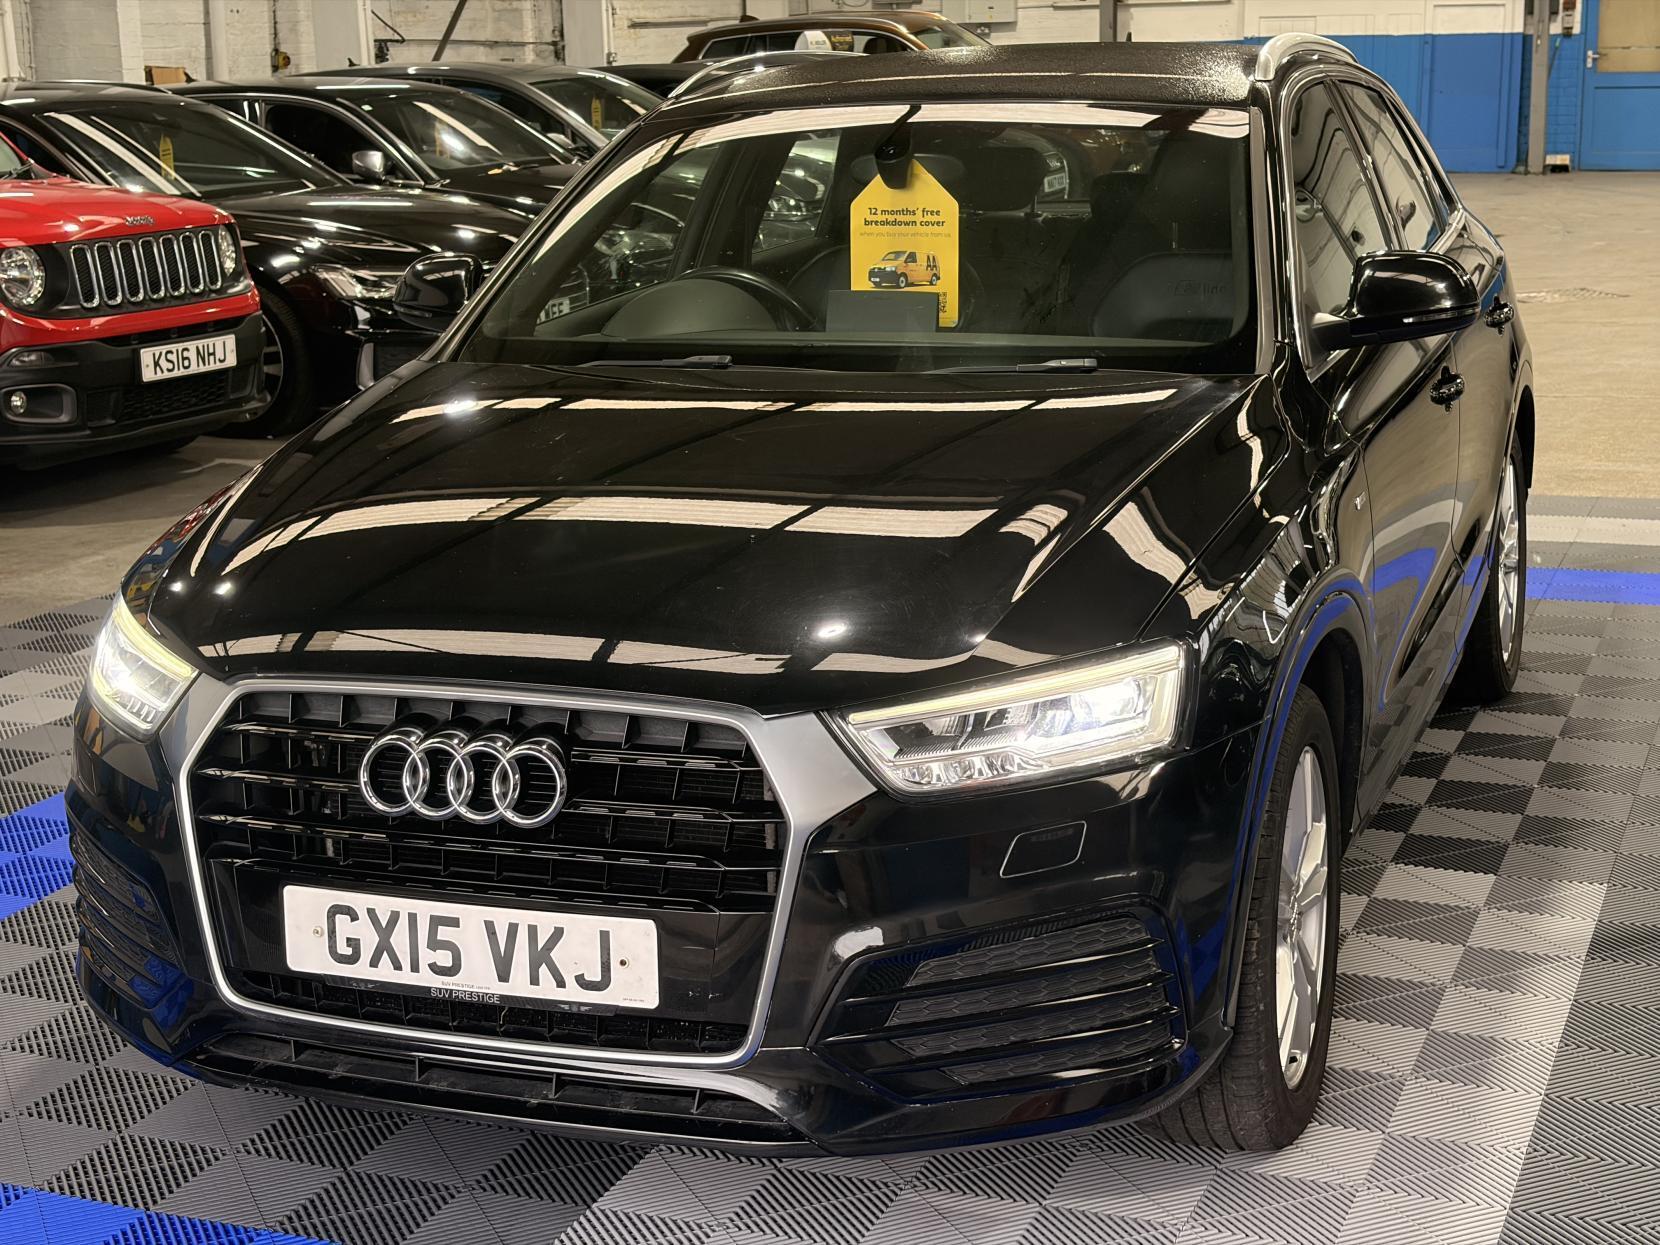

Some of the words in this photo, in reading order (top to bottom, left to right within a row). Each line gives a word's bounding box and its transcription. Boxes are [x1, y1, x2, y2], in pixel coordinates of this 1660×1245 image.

[868, 207, 878, 216] 12
[880, 207, 919, 217] months'
[922, 207, 941, 218] free
[864, 217, 918, 227] breakdown
[919, 219, 946, 227] cover
[926, 254, 938, 271] AA
[152, 347, 191, 376] KS16
[195, 340, 226, 368] NHJ
[326, 903, 462, 978] GX15
[483, 919, 612, 992] VKJ
[430, 987, 450, 998] SUV
[452, 990, 500, 1004] PRESTIGE
